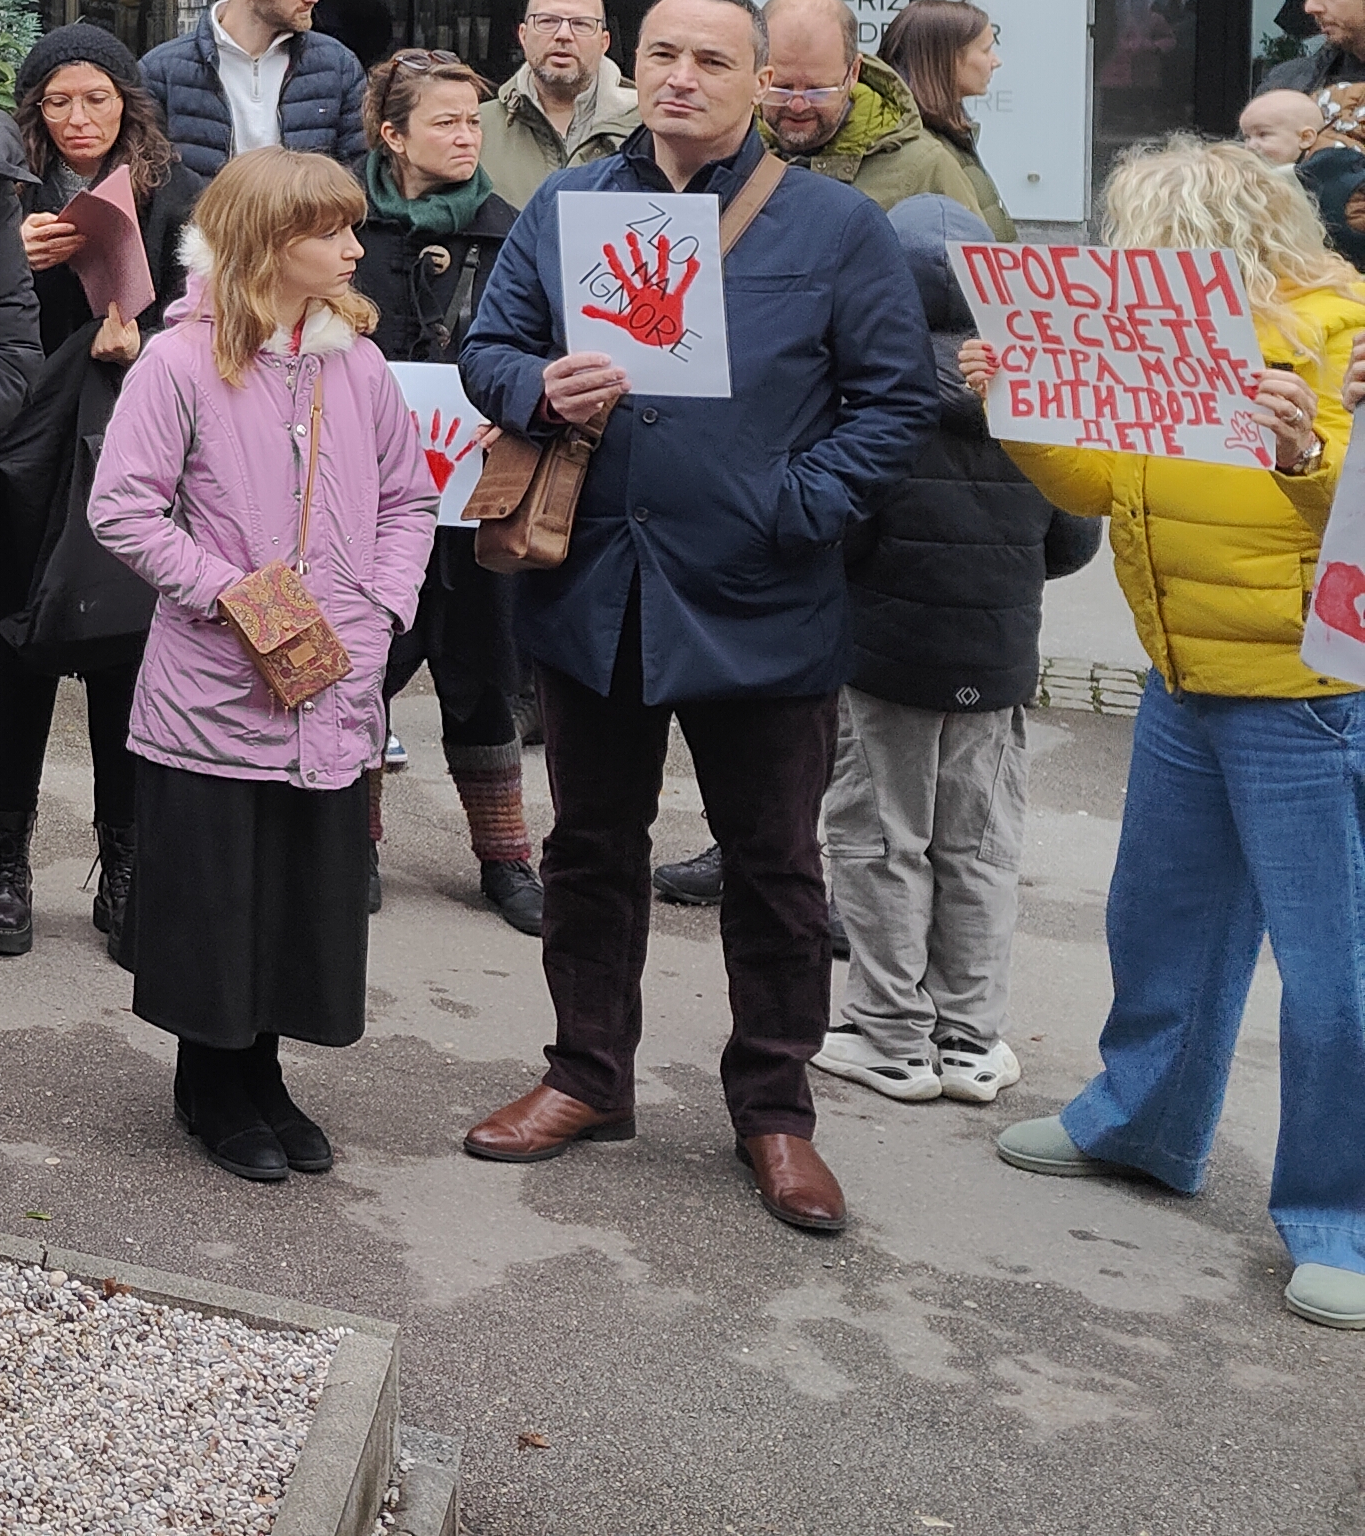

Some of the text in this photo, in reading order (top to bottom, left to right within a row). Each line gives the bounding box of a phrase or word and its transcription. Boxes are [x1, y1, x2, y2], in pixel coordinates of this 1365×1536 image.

[626, 201, 699, 265] ZLO
[630, 261, 670, 301] NA
[961, 245, 1244, 319] ПРОБУДИ
[579, 262, 703, 363] IGNORE
[1006, 310, 1230, 360] СЕ СВЕТЕ
[1001, 345, 1257, 395] СУТРА МОЖЕ
[1008, 379, 1223, 426] БИТИ ТВОЈЕ
[1075, 419, 1185, 456] ДЕТЕ
